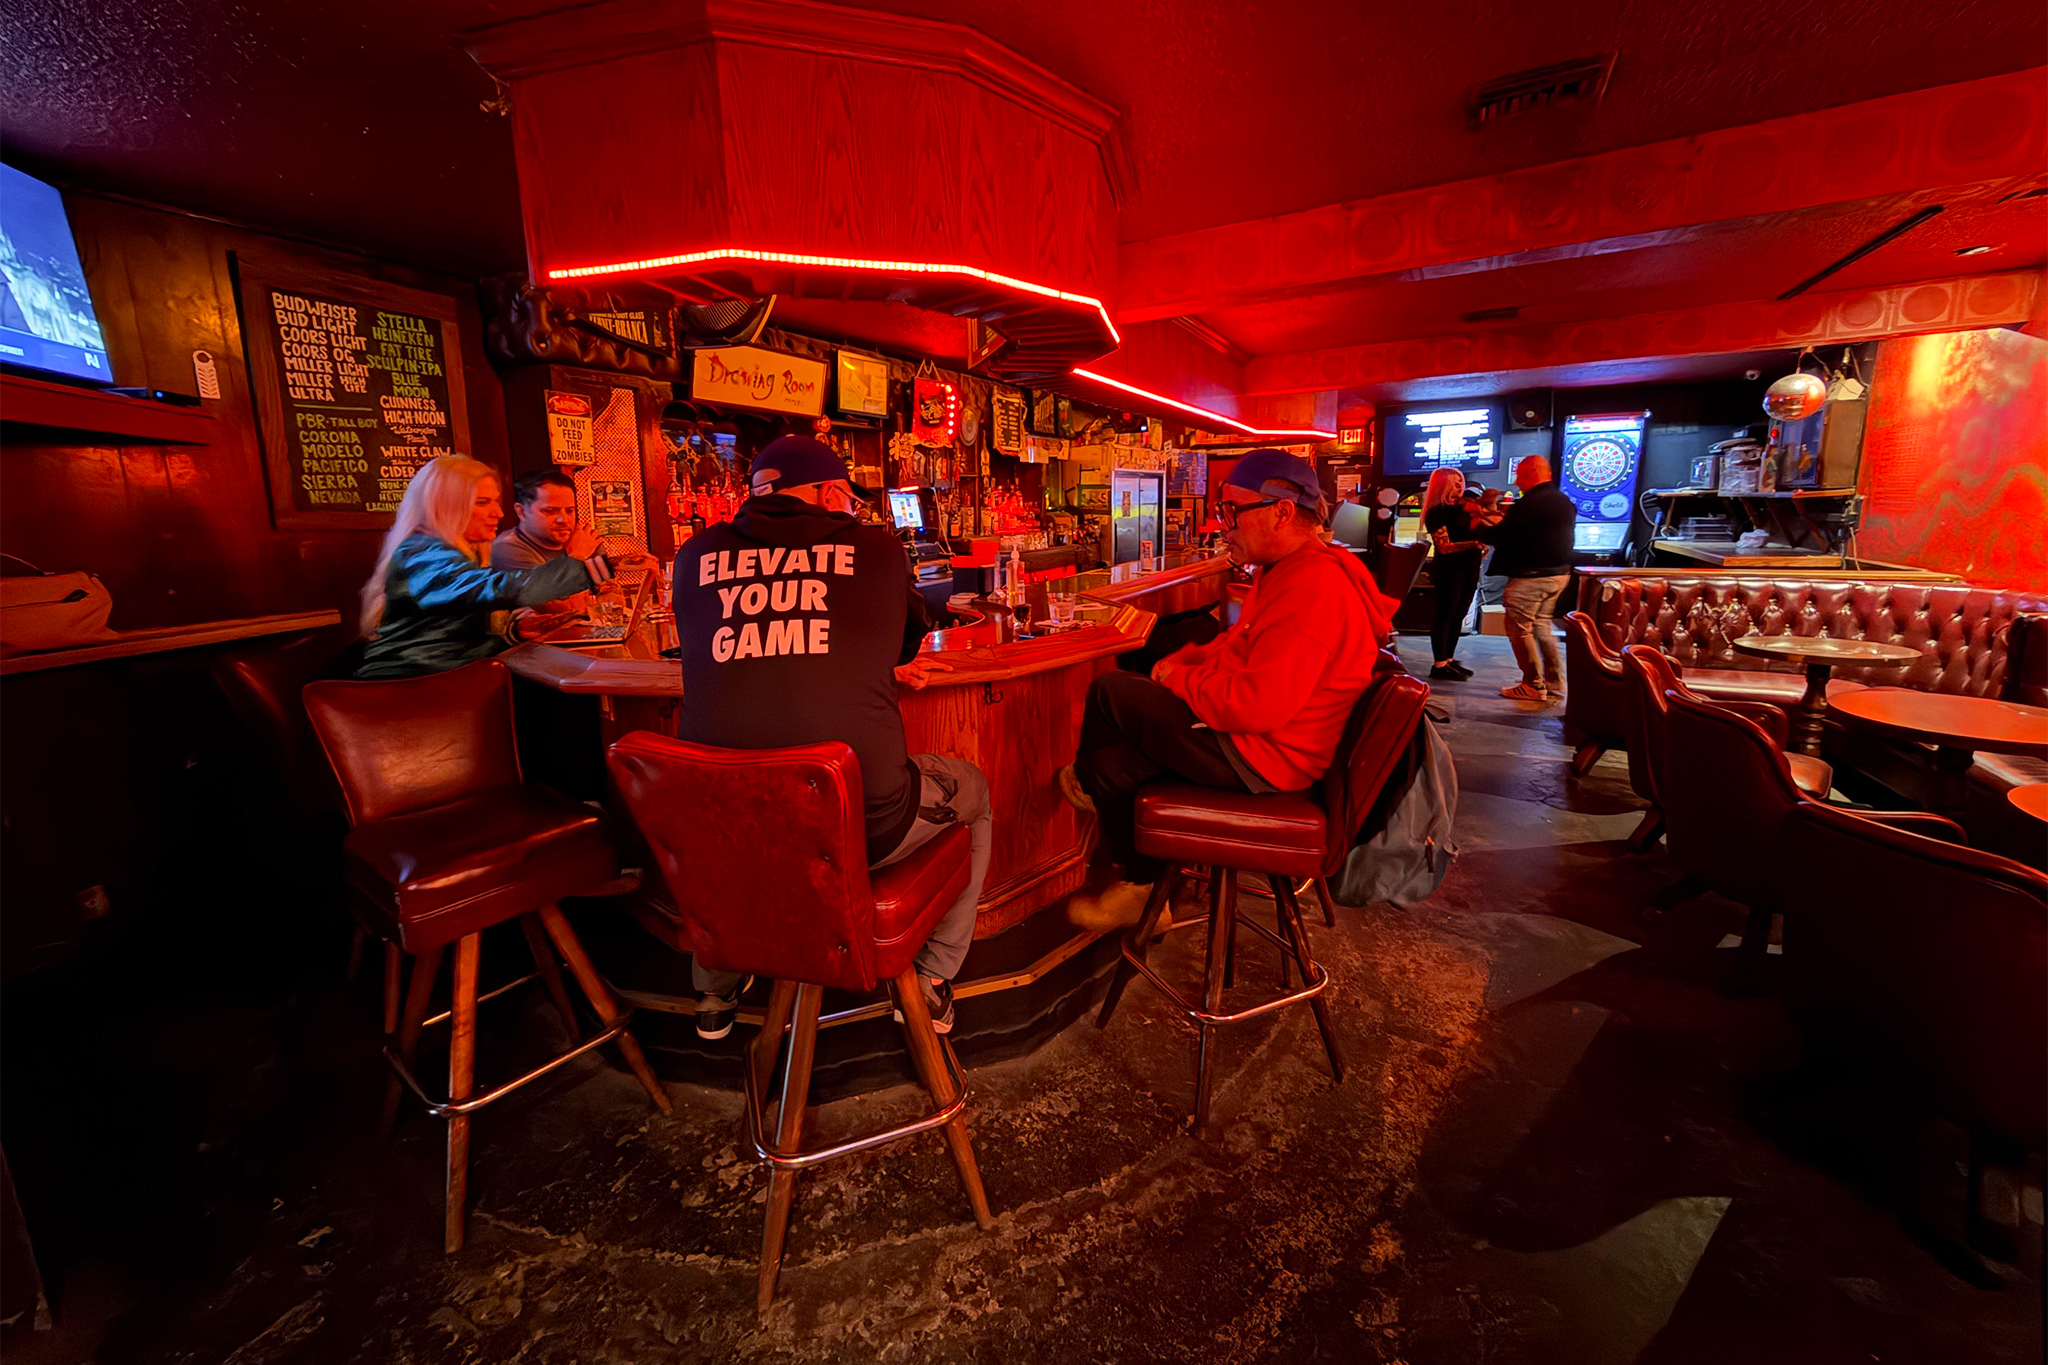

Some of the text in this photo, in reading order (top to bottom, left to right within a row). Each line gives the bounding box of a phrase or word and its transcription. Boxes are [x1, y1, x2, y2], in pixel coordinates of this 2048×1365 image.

[272, 292, 357, 322] BUDWEISER
[275, 310, 356, 336] BUD LIGHT
[377, 312, 427, 333] STELLA
[280, 326, 367, 351] COORS LIGHT
[372, 326, 434, 347] HEINEKEN
[282, 342, 356, 364] COORS OG
[380, 342, 434, 362] FAT TIRE
[284, 356, 370, 377] MILLER LIGHT
[286, 372, 366, 388] MILLER HIGH
[392, 372, 422, 386] BLUE
[781, 370, 815, 395] Room
[289, 387, 335, 402] ULTRA
[344, 384, 367, 394] LIFE
[392, 386, 430, 399] MOON
[380, 395, 436, 412] GUINNESS
[357, 418, 378, 428] BOY
[556, 418, 586, 430] DO NOT
[299, 430, 360, 444] CORONA
[562, 428, 582, 440] FEED
[1344, 429, 1361, 443] EXIT
[302, 444, 364, 458] MODELO
[380, 446, 450, 458] WHITE CLAW
[566, 440, 582, 450] THE
[556, 450, 592, 462] ZOMBIES
[302, 459, 368, 473] PACIFICO
[380, 465, 416, 478] CIDER
[301, 474, 358, 490] SIERRA
[309, 490, 362, 504] NEVADA
[699, 544, 855, 586] ELEVATE
[718, 579, 828, 619] YOUR
[712, 619, 830, 663] GAME
